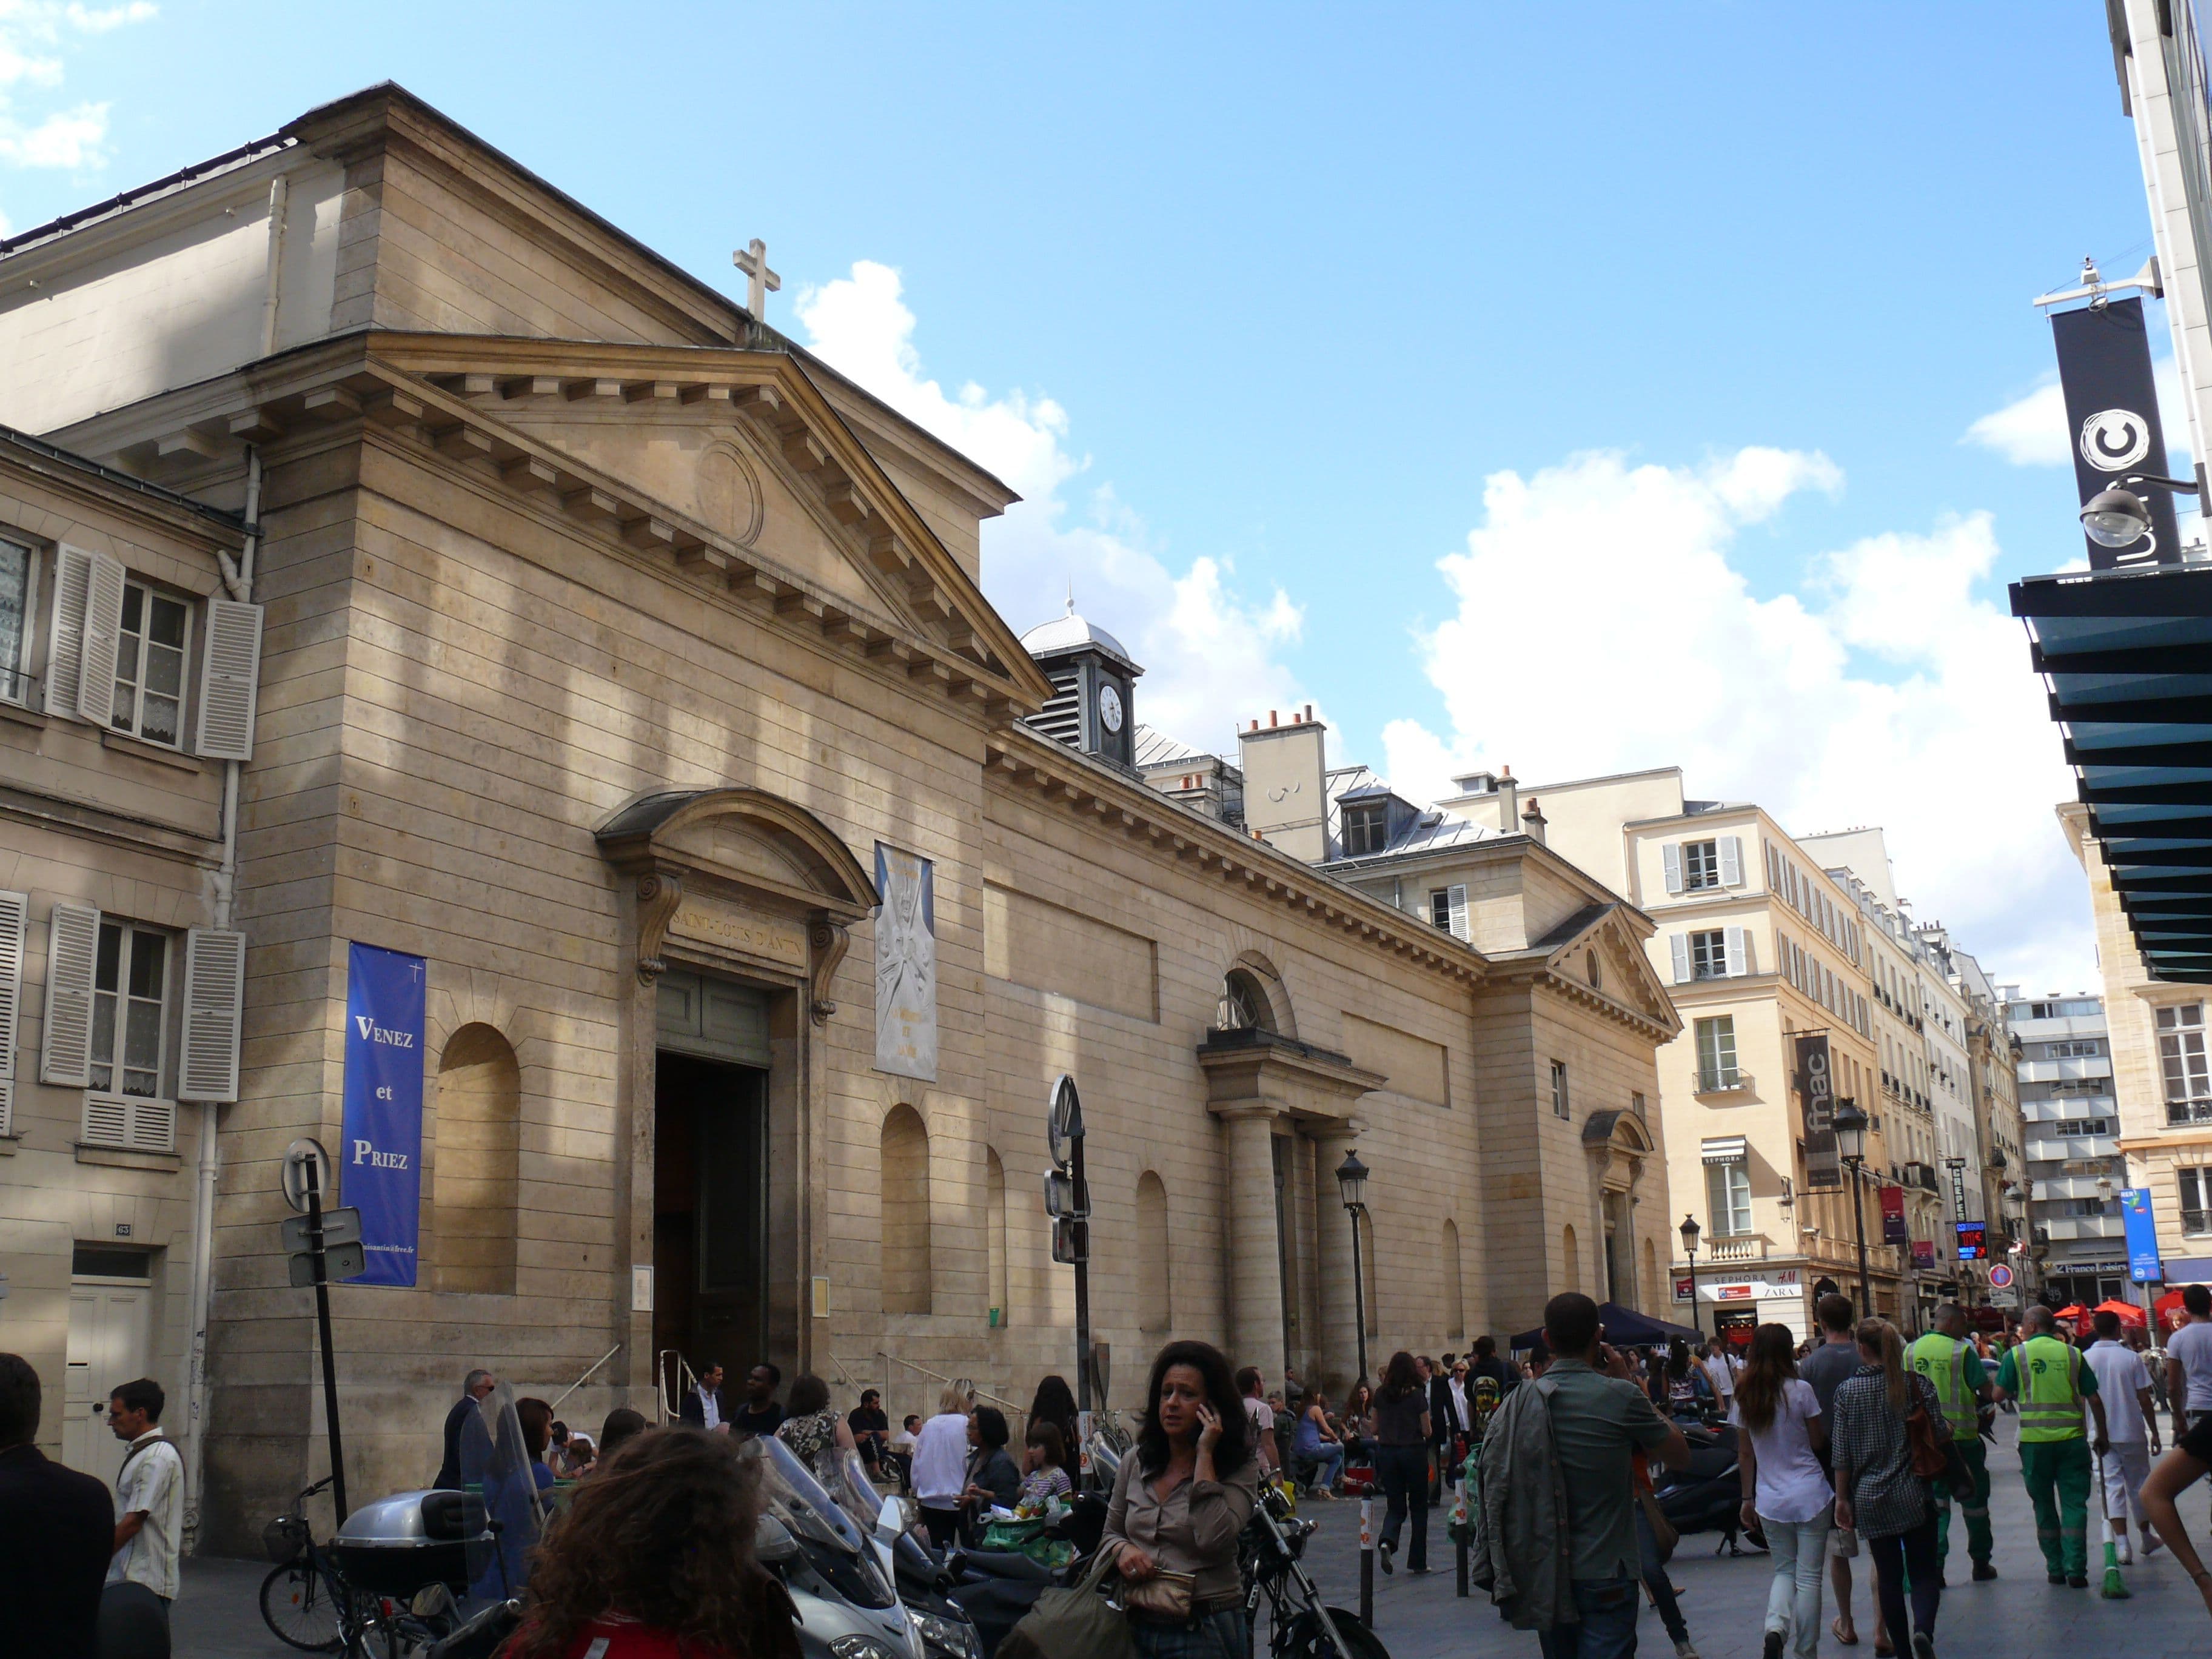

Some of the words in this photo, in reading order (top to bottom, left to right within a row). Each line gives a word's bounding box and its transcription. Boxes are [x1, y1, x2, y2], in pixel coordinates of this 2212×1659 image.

[355, 1016, 413, 1048] VENEZ
[376, 1085, 392, 1101] et
[1807, 1053, 1832, 1134] fnac
[352, 1139, 408, 1170] PRIEZ
[1952, 1168, 1966, 1221] CREPES
[1956, 1222, 1984, 1232] MENU
[2065, 1264, 2096, 1273] France
[2096, 1262, 2127, 1272] Loisirs
[1715, 1273, 1766, 1284] SEPHORA
[1777, 1271, 1796, 1284] H&M
[1765, 1287, 1794, 1298] ZARA
